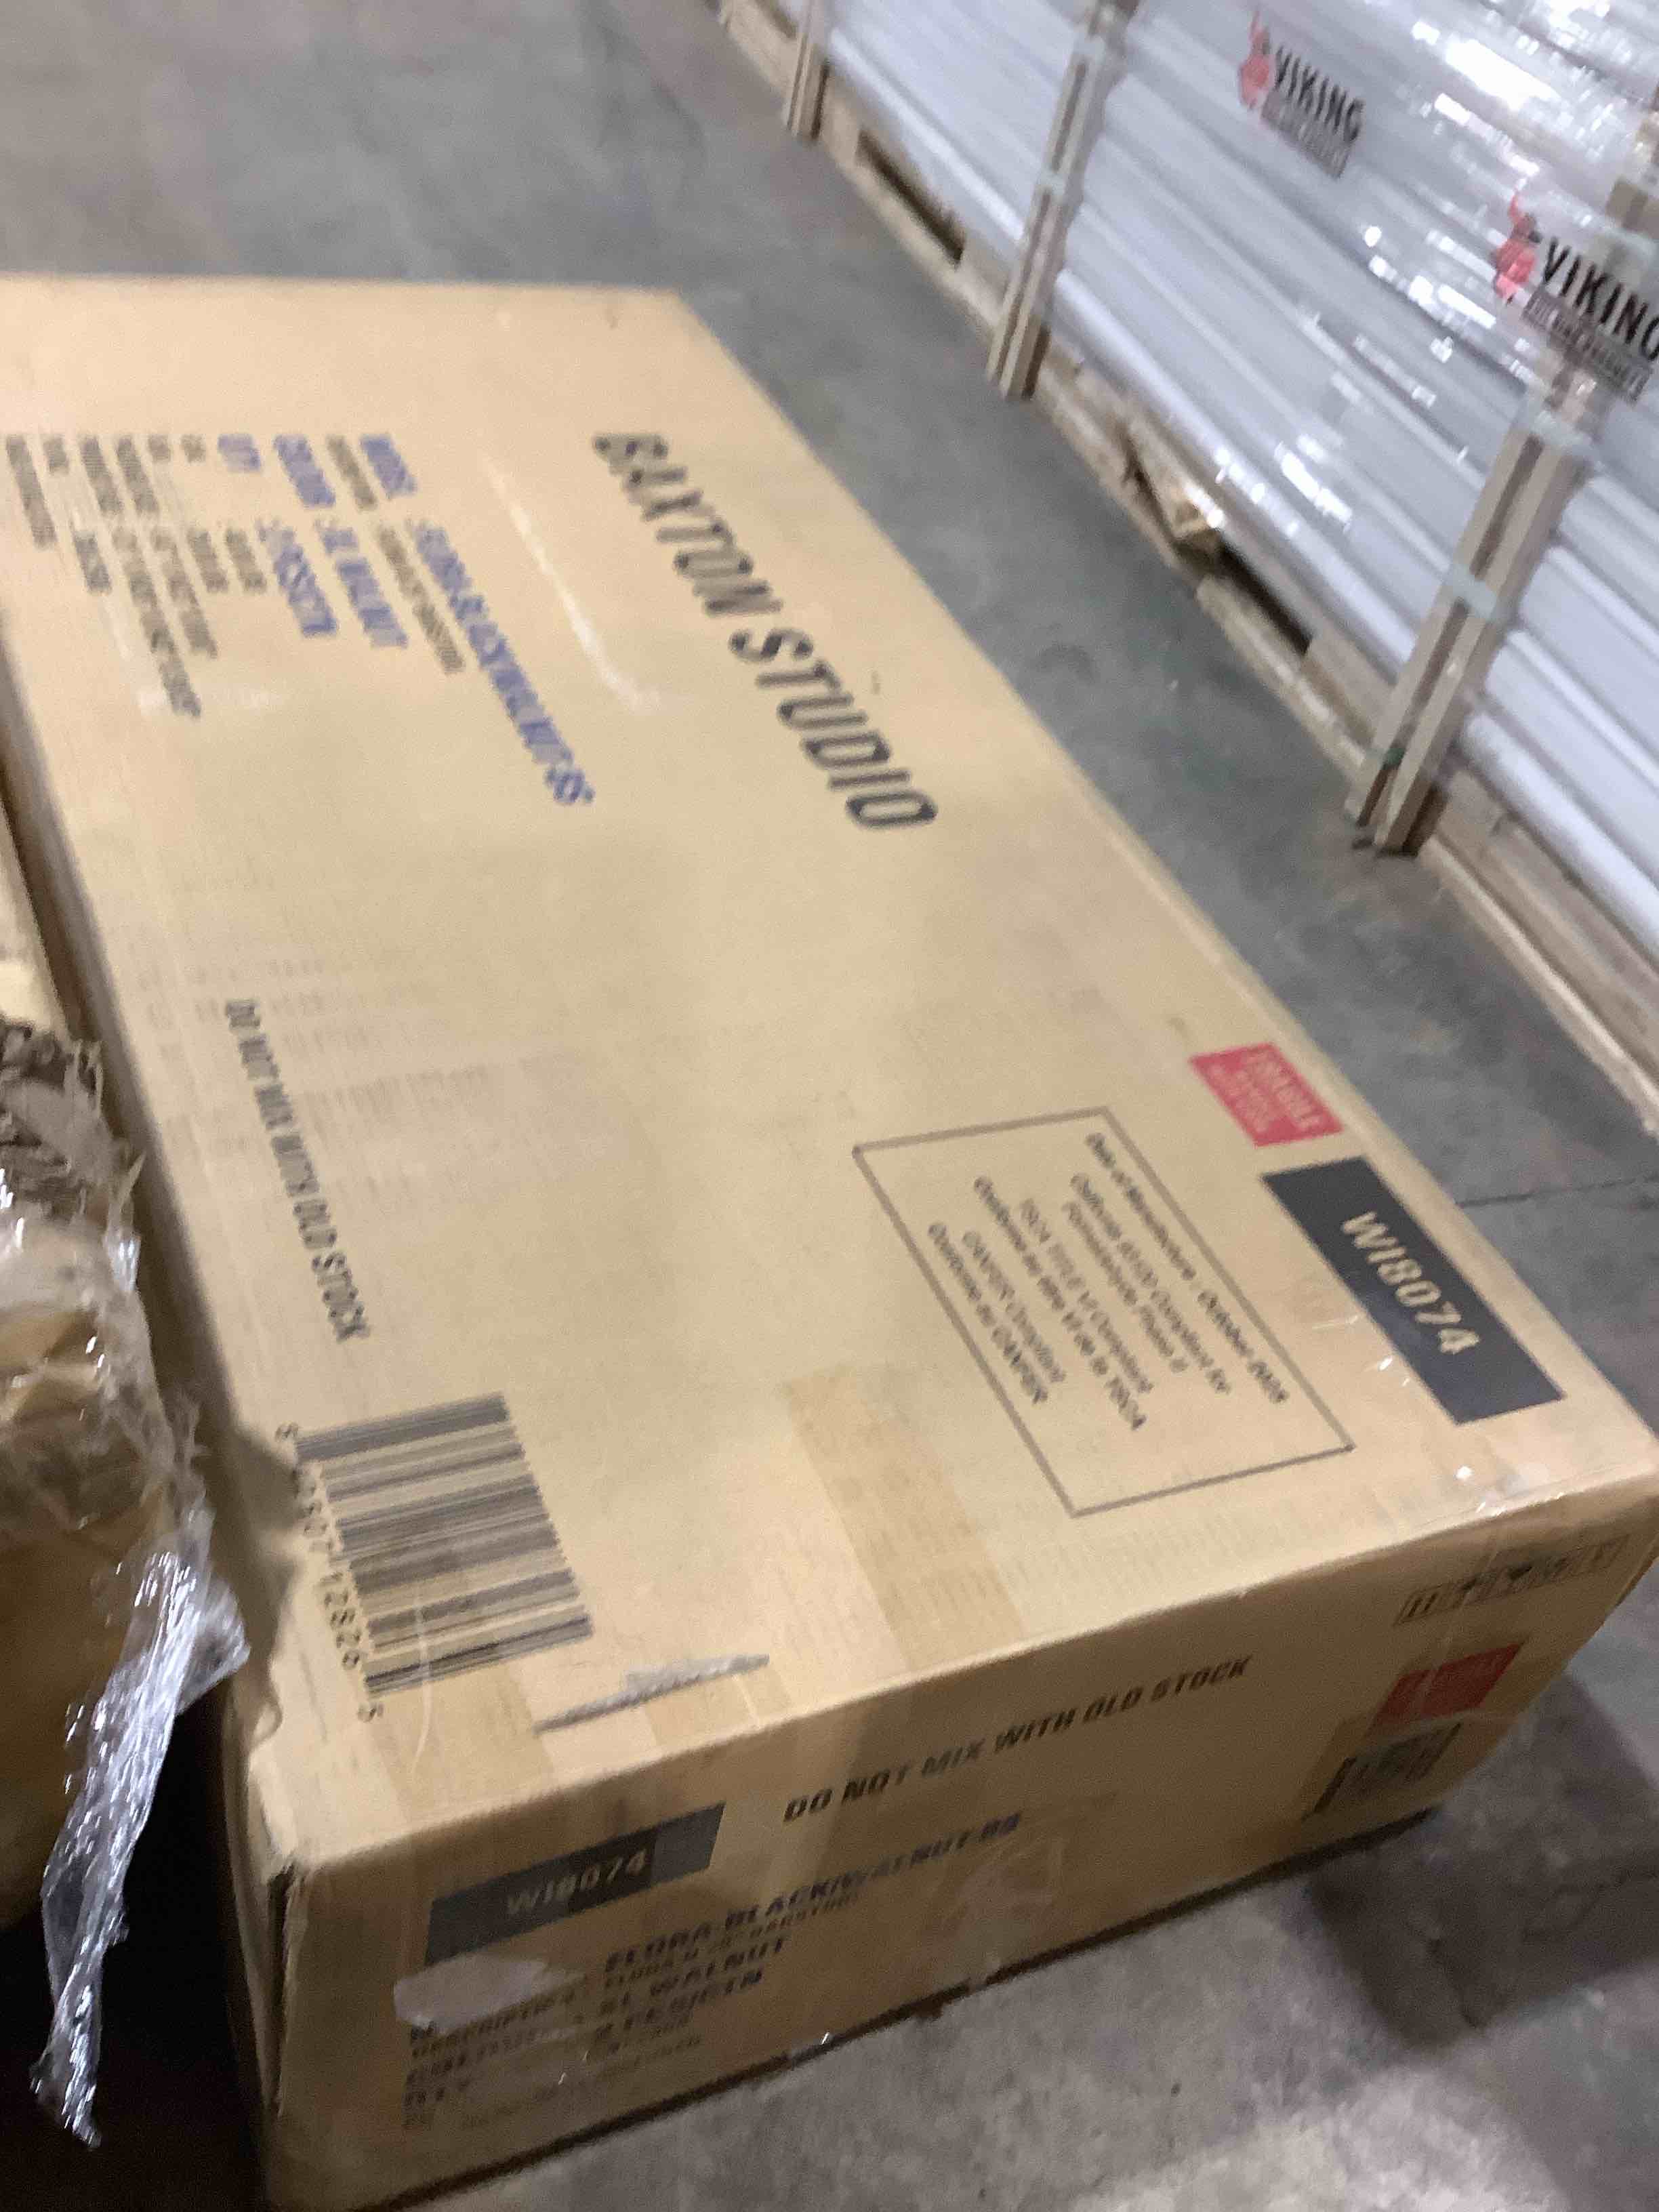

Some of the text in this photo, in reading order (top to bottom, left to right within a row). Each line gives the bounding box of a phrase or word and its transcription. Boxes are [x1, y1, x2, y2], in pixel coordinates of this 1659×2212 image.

[1275, 45, 1366, 143] VIKING
[728, 627, 938, 830] STUDIO
[293, 1198, 337, 1249] OLD
[1340, 1210, 1481, 1357] WI8074
[312, 1249, 371, 1344] STOCK
[783, 1654, 1253, 1822] DO NOT MIX WITH OLD STOCK
